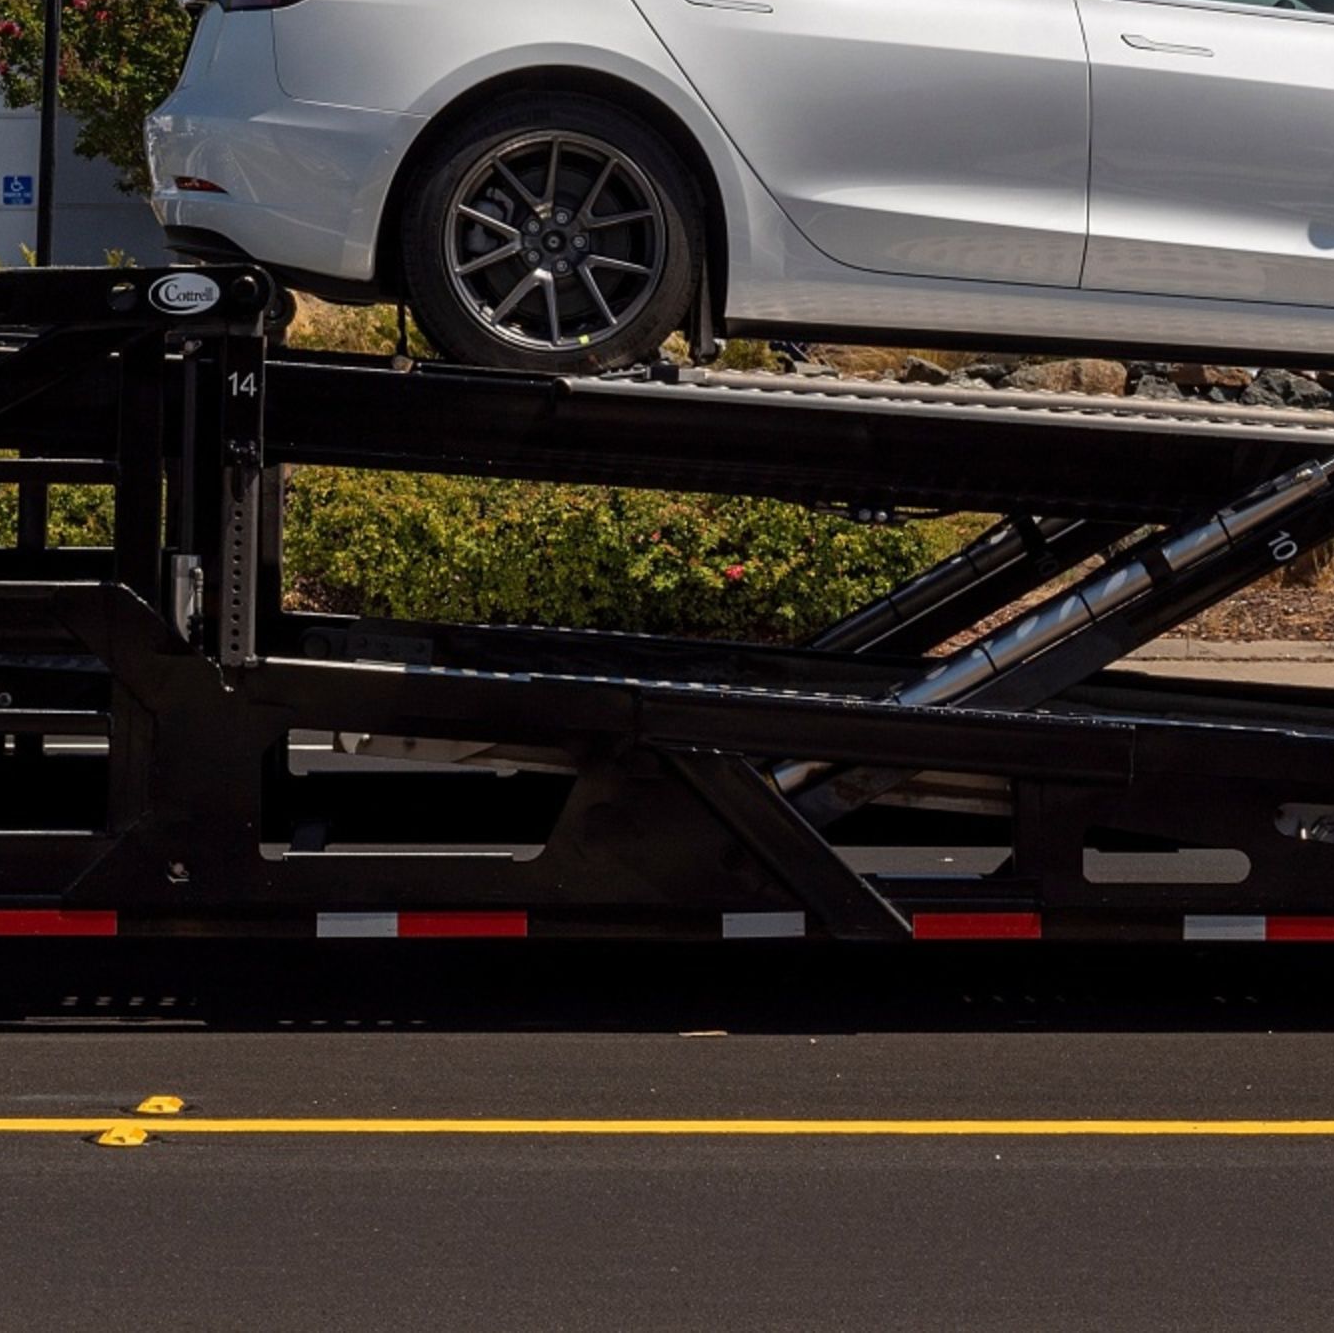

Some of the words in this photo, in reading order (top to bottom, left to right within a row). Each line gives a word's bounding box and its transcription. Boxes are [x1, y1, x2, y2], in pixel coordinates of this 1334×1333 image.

[165, 282, 214, 303] Cottrell
[228, 371, 257, 397] 14
[1268, 530, 1298, 561] 10
